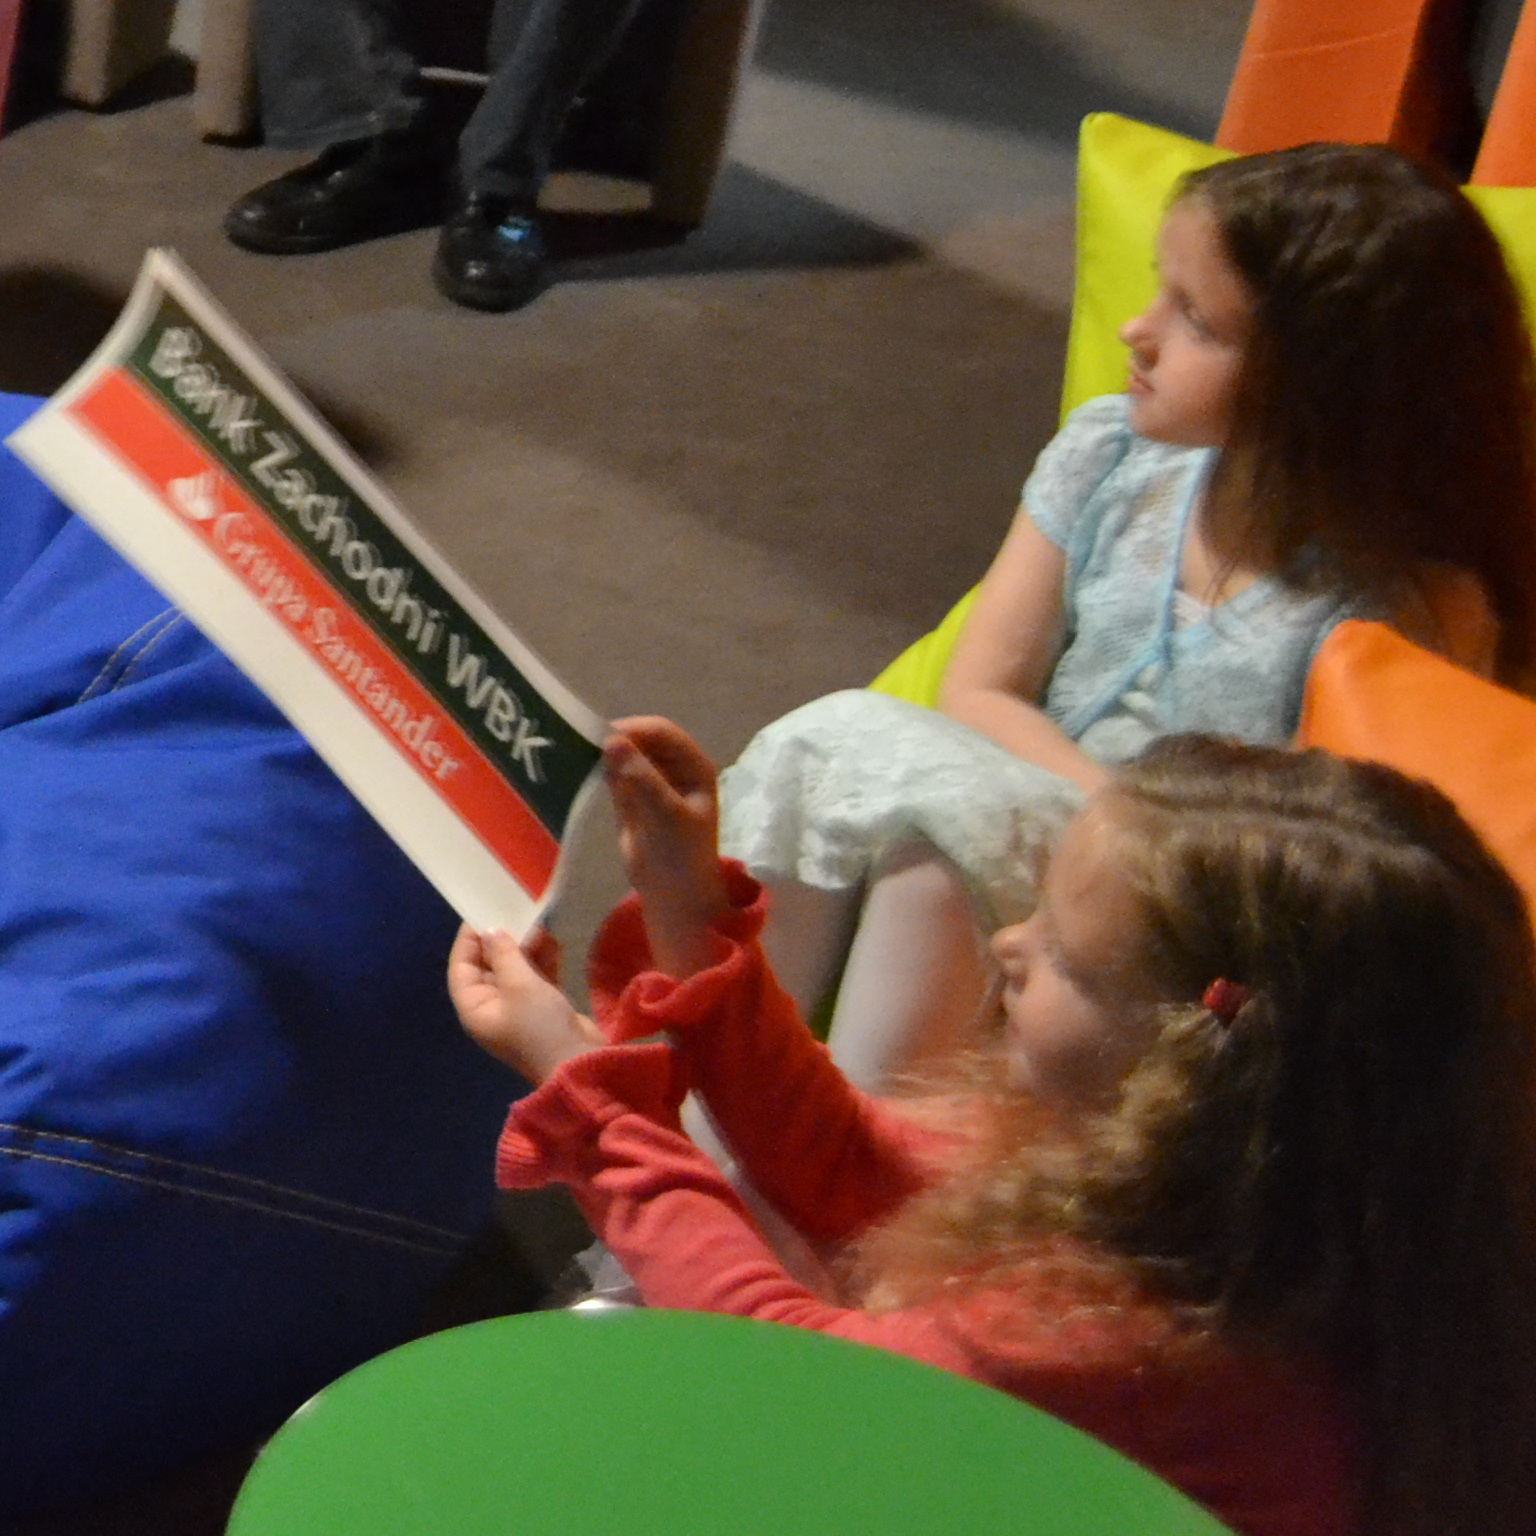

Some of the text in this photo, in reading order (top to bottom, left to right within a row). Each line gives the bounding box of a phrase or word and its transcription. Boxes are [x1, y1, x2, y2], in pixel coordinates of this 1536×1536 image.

[148, 326, 557, 785] Bank Zachodni WBK
[211, 511, 461, 781] Grupa Santander
